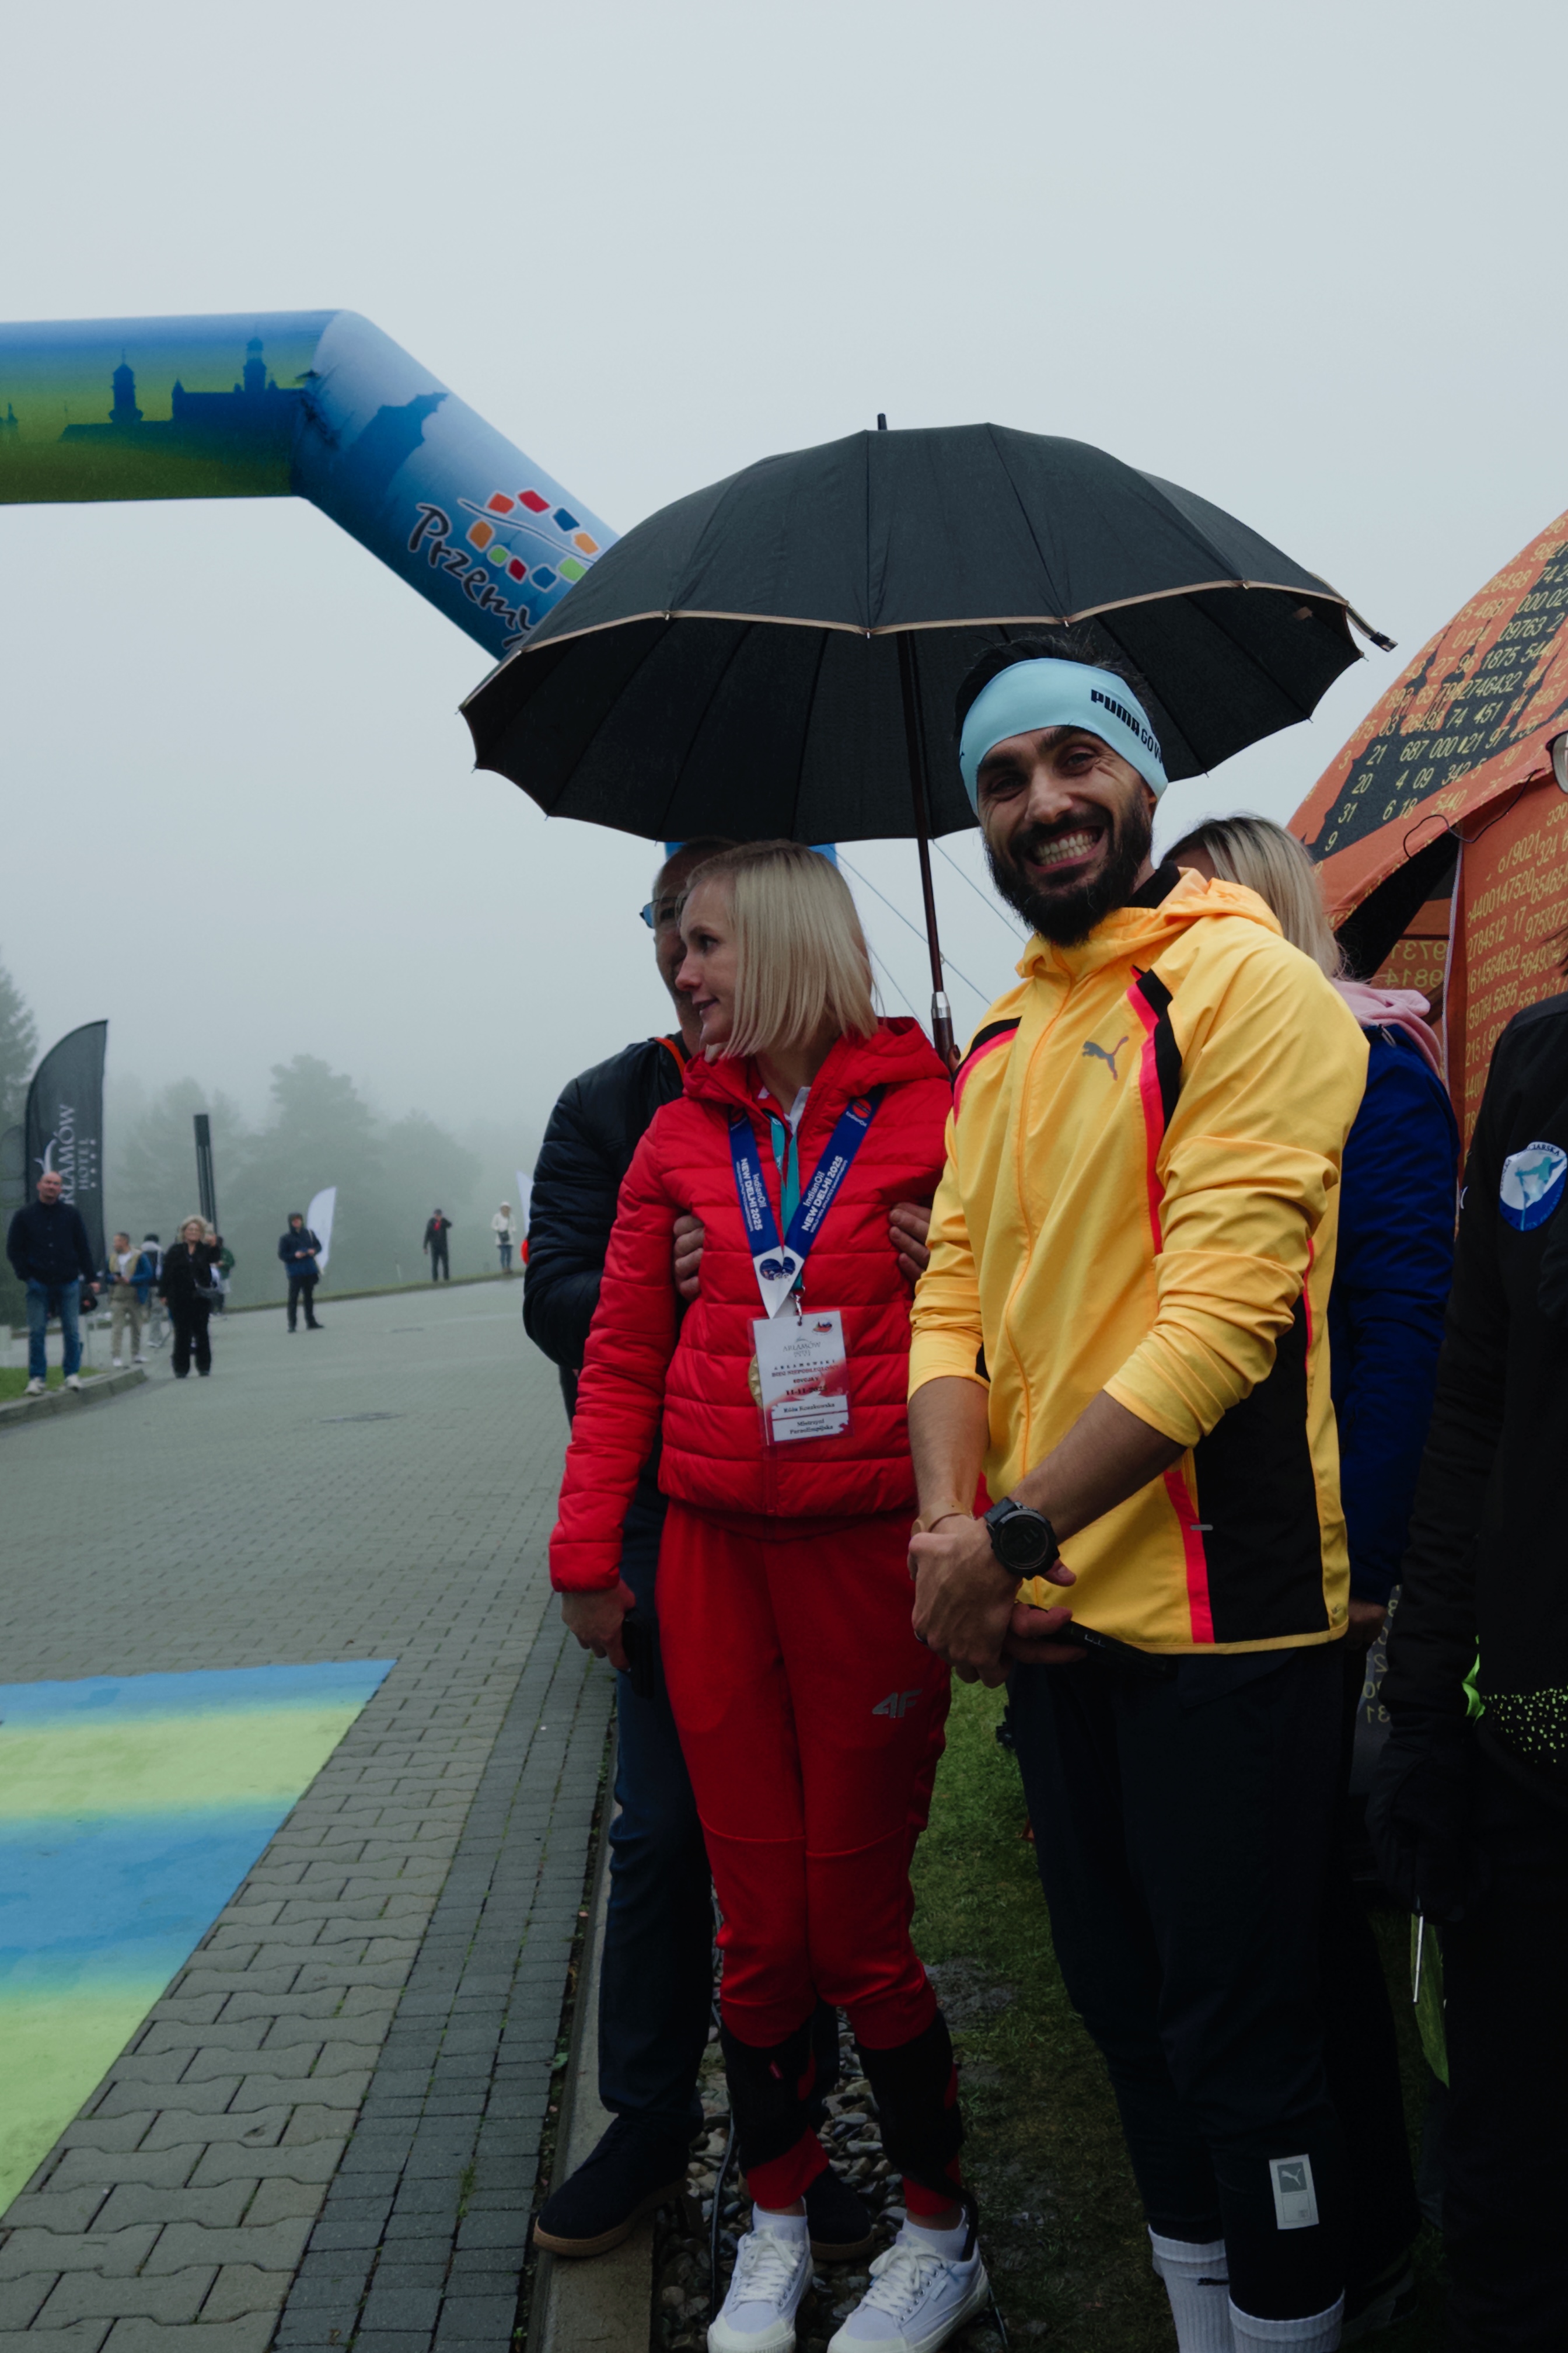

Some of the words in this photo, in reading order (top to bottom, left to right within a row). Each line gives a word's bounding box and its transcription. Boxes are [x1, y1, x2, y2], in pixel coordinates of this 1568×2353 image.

[408, 503, 535, 650] Przemy
[1497, 615, 1548, 643] 09763
[1430, 656, 1457, 677] 27
[1482, 645, 1522, 671] 1875
[1091, 689, 1140, 736] PUMA
[1378, 715, 1399, 736] 03
[1445, 707, 1469, 729] 74
[1338, 750, 1352, 770] 3
[1366, 743, 1388, 766] 21
[1399, 739, 1430, 762] 687
[1429, 735, 1459, 759] 000
[1485, 725, 1511, 750] 97
[1351, 773, 1374, 794] 20
[1395, 769, 1410, 790] 4
[1412, 767, 1435, 790] 09
[1470, 757, 1487, 780] 5
[1337, 802, 1359, 824] 31
[1382, 799, 1396, 821] 6
[1398, 797, 1419, 820] 18
[1325, 830, 1339, 852] 9
[739, 1157, 752, 1180] NEW
[743, 1179, 759, 1208] DELHI
[801, 1205, 819, 1231] NEW
[812, 1176, 833, 1207] DELHI
[827, 1155, 844, 1179] 2025
[802, 1170, 826, 1207] IndianOil
[750, 1207, 763, 1231] 2025
[871, 1688, 923, 1719] 4F
